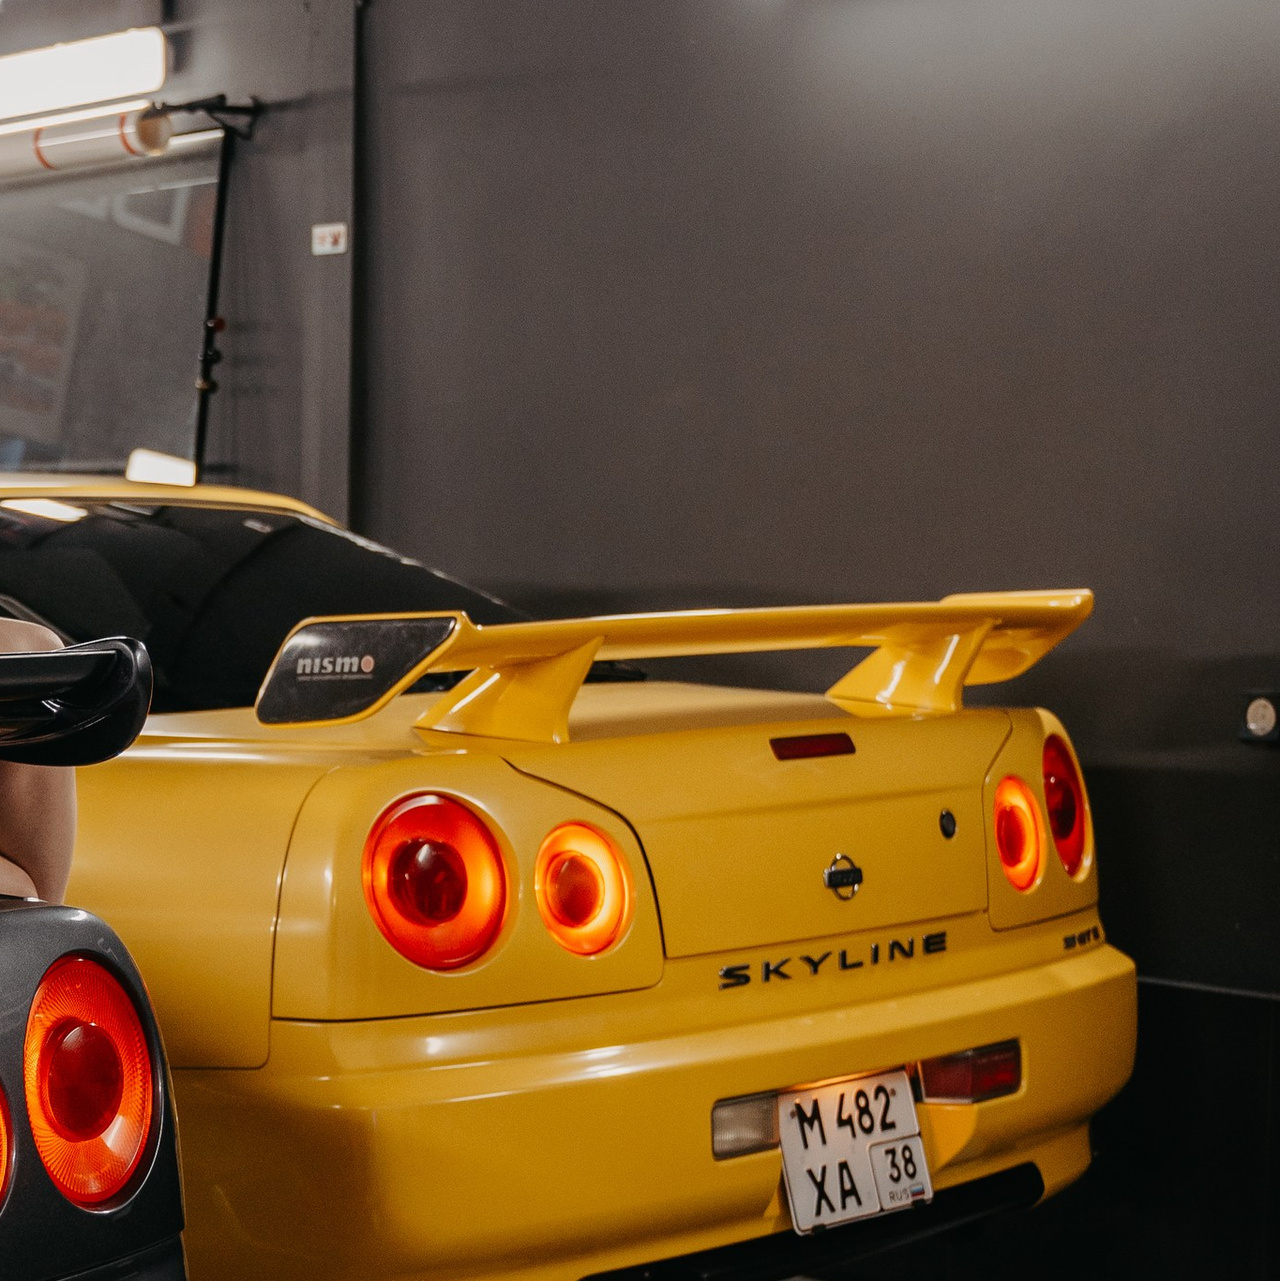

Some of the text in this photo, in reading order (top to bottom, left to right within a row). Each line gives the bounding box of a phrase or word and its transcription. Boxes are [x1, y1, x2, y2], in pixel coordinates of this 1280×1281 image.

[296, 655, 375, 674] nismo
[718, 930, 948, 990] SKYLINE
[794, 1085, 897, 1150] M 482
[884, 1144, 918, 1184] 38
[806, 1160, 863, 1217] XA
[888, 1187, 910, 1203] RUS
